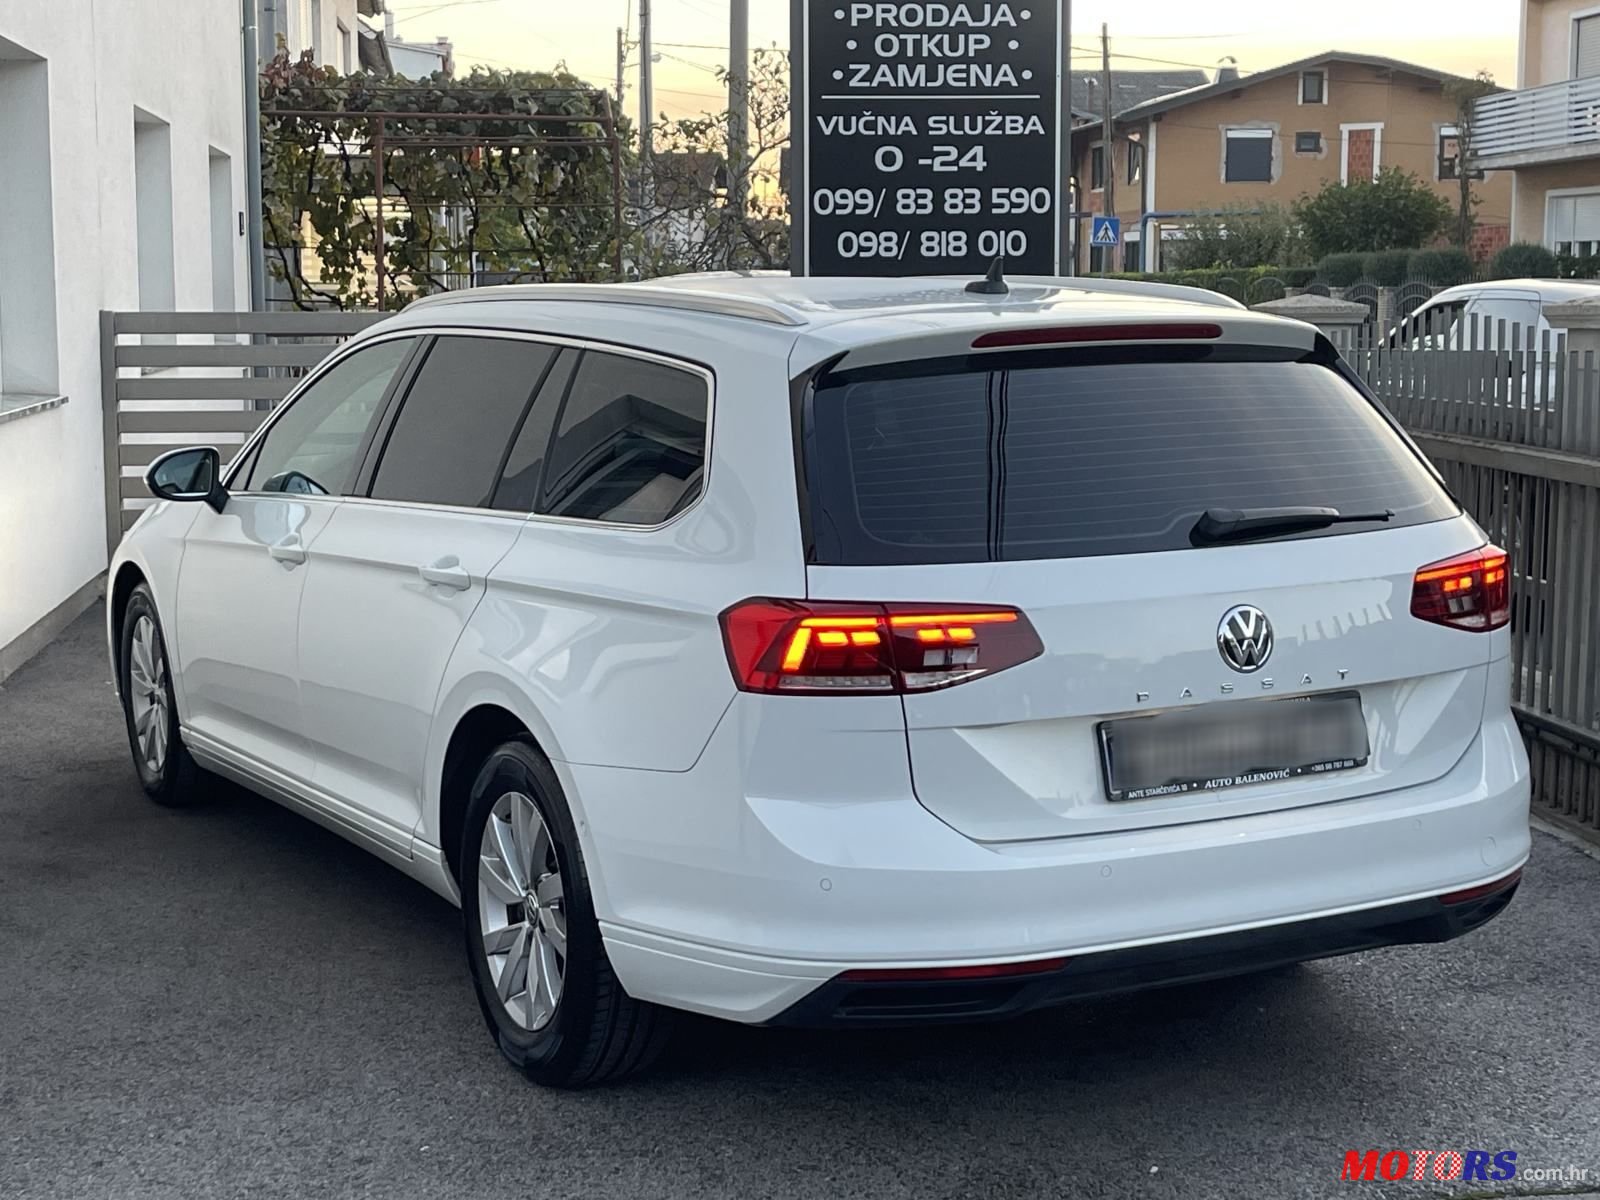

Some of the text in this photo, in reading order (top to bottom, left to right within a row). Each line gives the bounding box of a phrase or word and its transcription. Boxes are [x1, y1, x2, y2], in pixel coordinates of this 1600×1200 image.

[850, 3, 1017, 27] PRODAJA
[874, 33, 991, 58] OTKUP
[848, 63, 1019, 88] ZAMJENA
[816, 110, 1046, 136] VUČNA SLUŽBA
[813, 187, 1051, 219] 099/ 83 83 590
[837, 230, 1028, 261] 098/ 818 010
[1136, 668, 1349, 703] PASSAT
[1204, 768, 1290, 789] AUTO BALENOVIĆ
